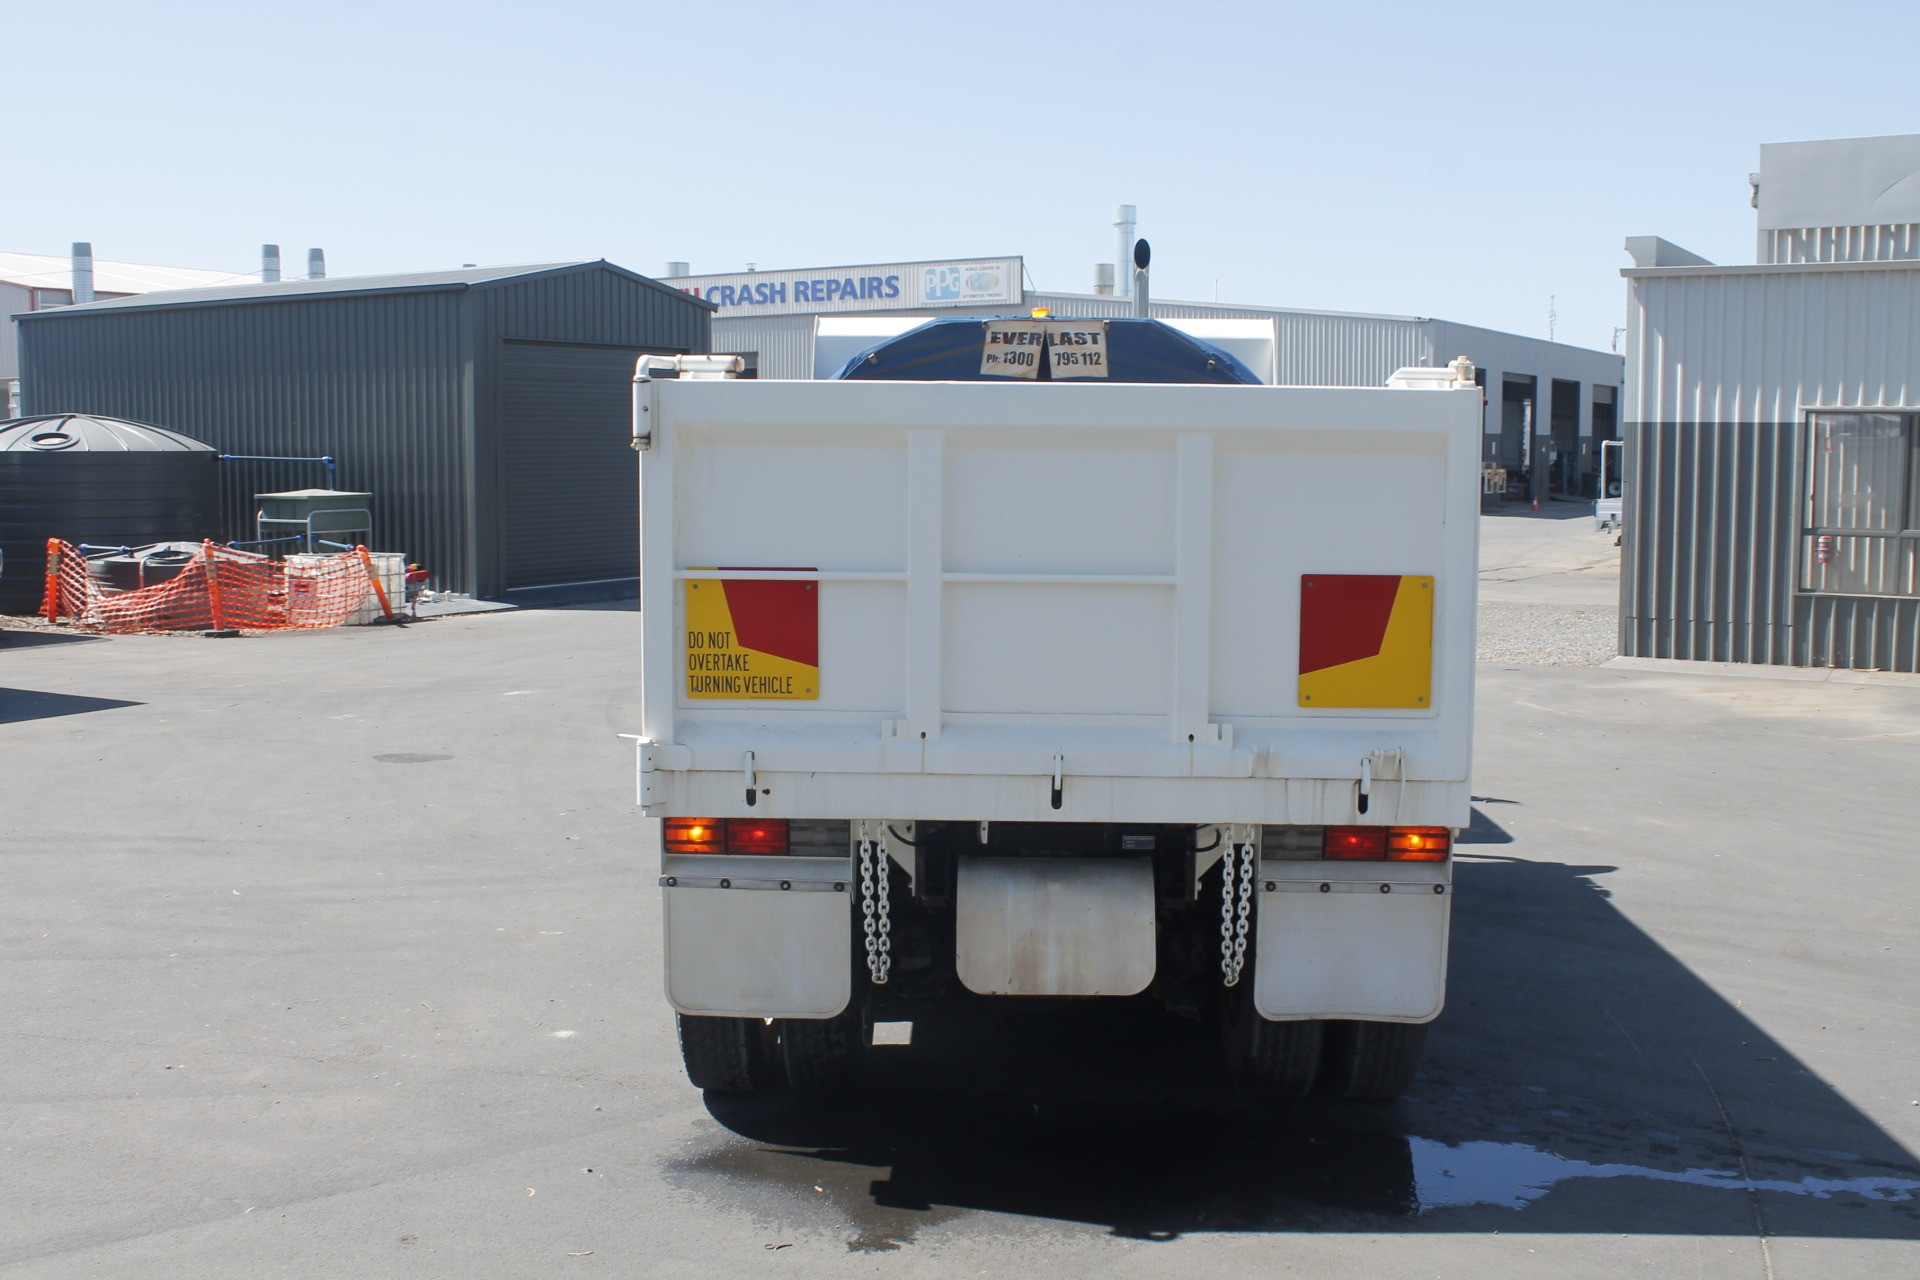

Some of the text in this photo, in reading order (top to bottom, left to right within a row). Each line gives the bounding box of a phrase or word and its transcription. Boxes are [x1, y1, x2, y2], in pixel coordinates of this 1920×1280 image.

[706, 282, 786, 306] CRASH
[794, 275, 900, 303] REPAIRS
[926, 267, 960, 297] PPG
[1003, 351, 1034, 367] 1300
[1055, 352, 1079, 366] 795
[1081, 352, 1101, 366] 112
[688, 631, 730, 649] DO NOT
[689, 653, 750, 671] OVERTAKE
[689, 675, 793, 694] TURNING VEHICLE
